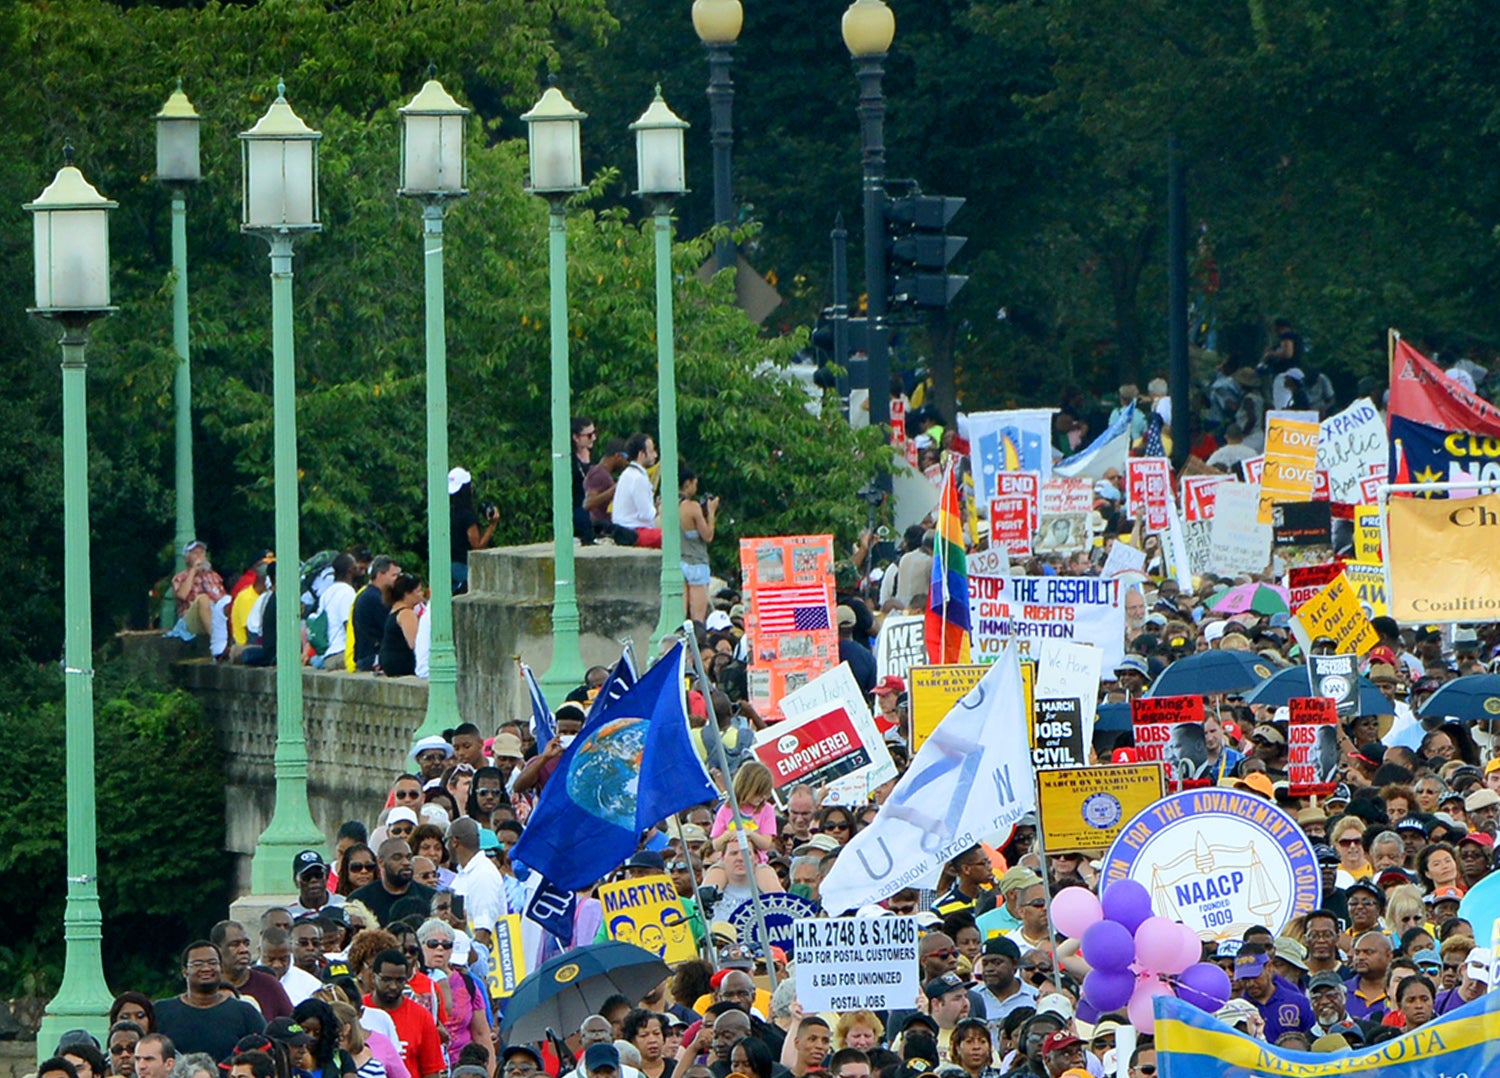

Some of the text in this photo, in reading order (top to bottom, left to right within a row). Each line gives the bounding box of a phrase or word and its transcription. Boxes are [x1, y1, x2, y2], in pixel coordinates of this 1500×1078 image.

[1282, 431, 1319, 447] LOVE
[1278, 467, 1315, 482] LOVE
[1001, 478, 1034, 493] END
[994, 501, 1023, 511] UNITE
[995, 520, 1025, 531] FIGHT
[968, 575, 1119, 607] STOP THE ASSAULT!
[979, 603, 1075, 621] CIVIL RIGHTS
[1308, 582, 1344, 629] Are We
[1323, 607, 1345, 632] Our
[888, 621, 923, 647] WE
[1042, 701, 1074, 712] MARCH
[1133, 698, 1195, 712] Dr. King's
[1134, 727, 1171, 743] JOBS
[1289, 727, 1316, 744] JOBS
[776, 731, 850, 776] EMPOWERED
[1032, 748, 1074, 764] CIVIL
[1289, 746, 1311, 763] NOT
[1080, 778, 1092, 786] ON
[1095, 775, 1155, 785] WASHINGTON
[1289, 764, 1315, 783] WAR
[1174, 871, 1246, 907] NAACP
[603, 883, 678, 913] MARTYRS
[1201, 913, 1235, 929] 1909
[795, 920, 915, 947] H.R. 2748 & S.1486
[796, 947, 916, 964] BAD FOR POSTAL CUSTOMERS
[812, 971, 902, 987] & BAD FOR UNIONIZED
[830, 995, 886, 1008] POSTAL JOBS
